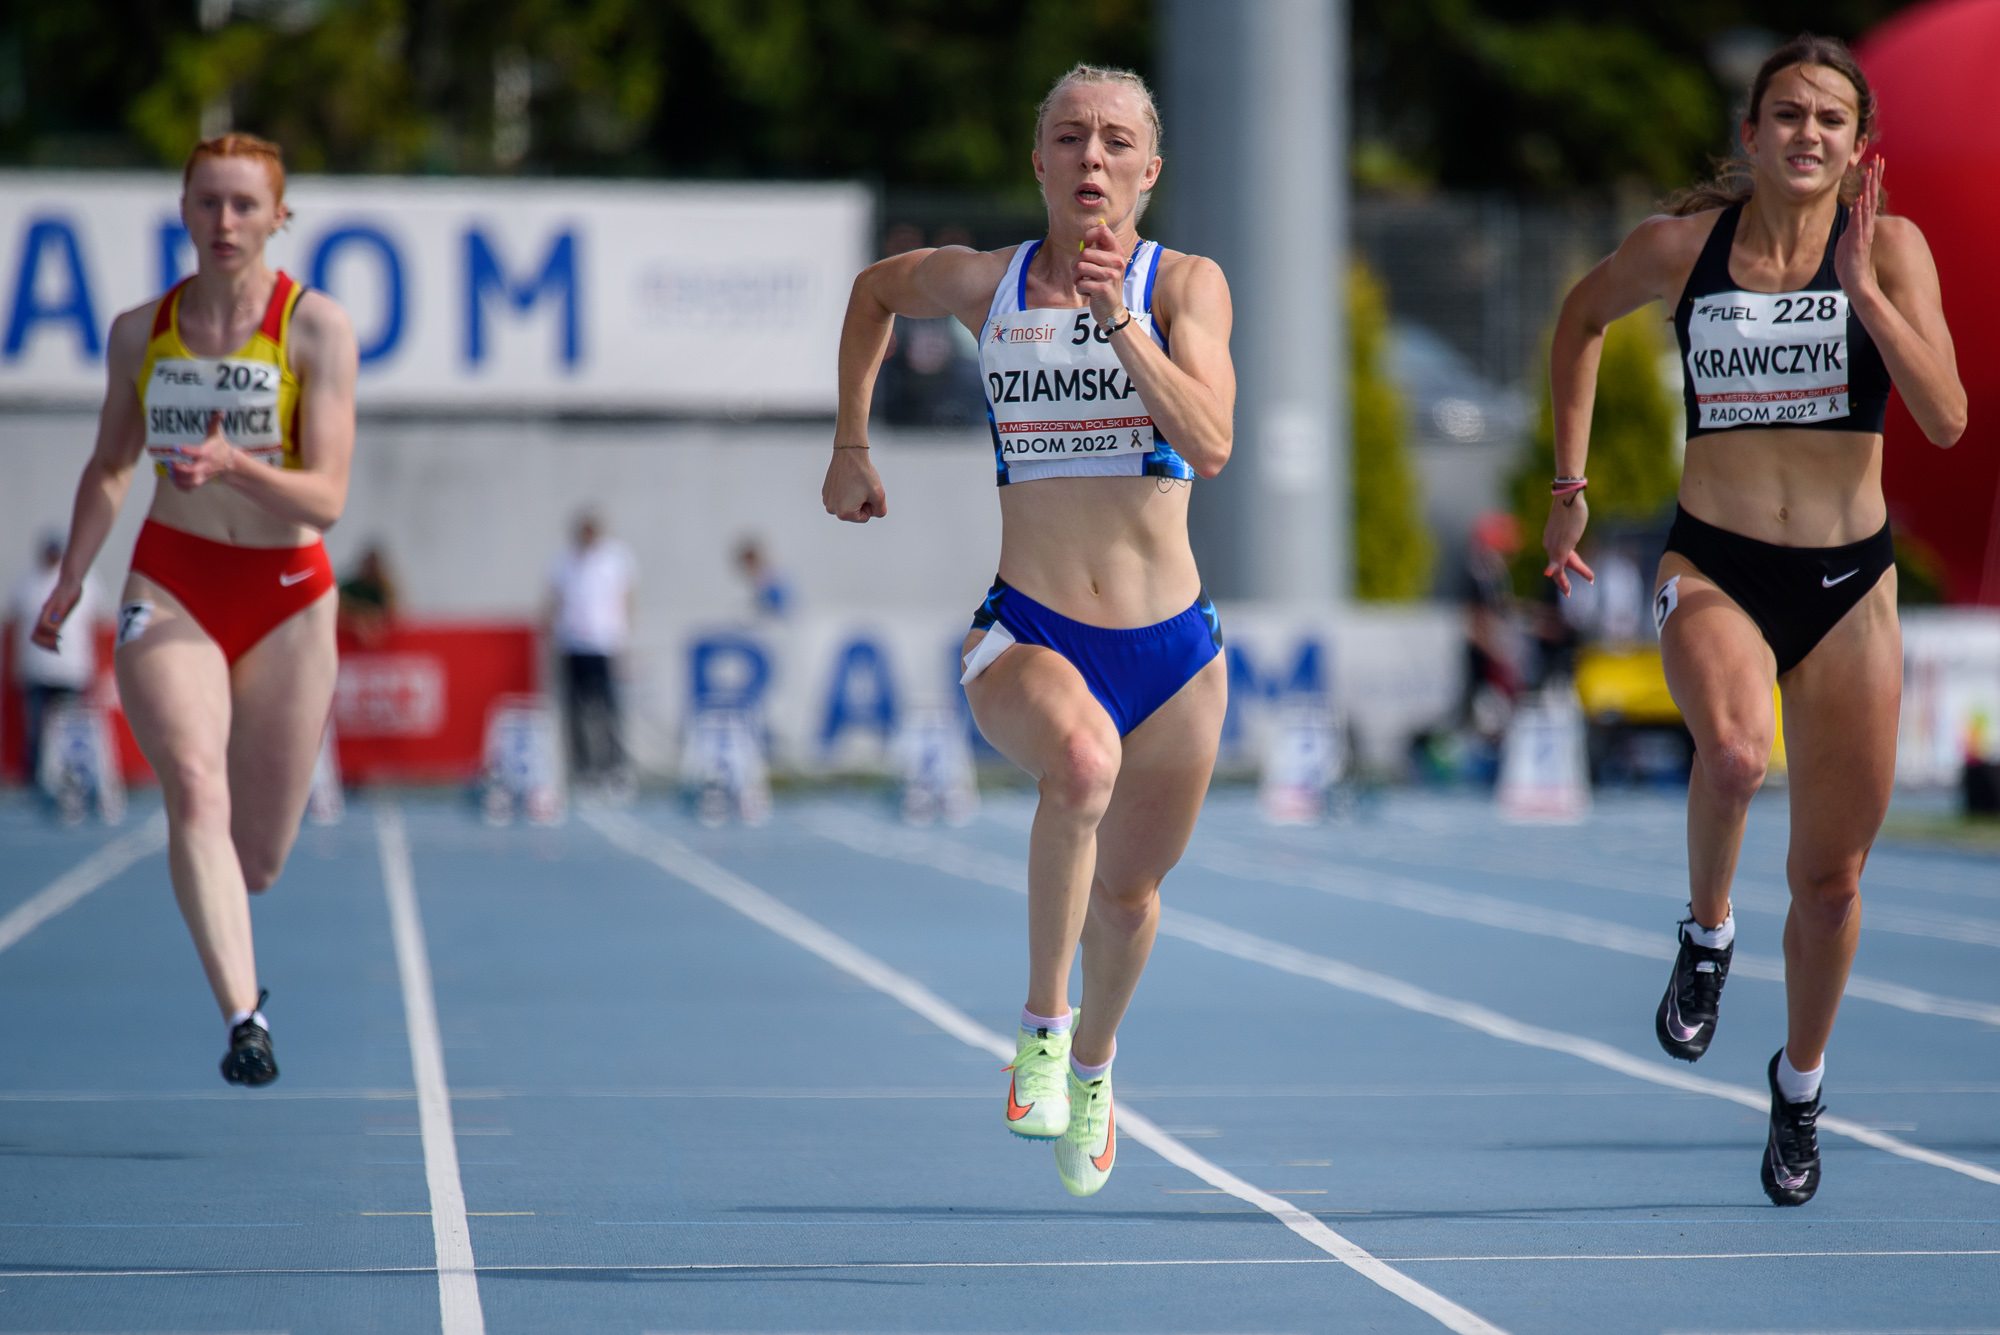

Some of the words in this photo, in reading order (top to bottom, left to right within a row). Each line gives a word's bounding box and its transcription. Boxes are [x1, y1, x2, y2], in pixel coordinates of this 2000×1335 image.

[3, 212, 586, 372] AOM
[1710, 306, 1758, 322] FUEL
[1772, 296, 1837, 324] 228
[1010, 324, 1056, 341] mosir
[1694, 342, 1842, 378] KRAWCZYK
[215, 364, 271, 391] 202
[1790, 389, 1823, 399] POLSKI
[1825, 386, 1845, 395] U20
[151, 407, 273, 434] SIENKIWICZ
[1709, 407, 1770, 422] RADOM
[1776, 402, 1818, 420] 2022
[1009, 421, 1083, 432] MISTRZOSTWA
[1086, 418, 1123, 430] POLSKI
[1126, 417, 1149, 426] U20
[1002, 437, 1066, 454] ADOM
[1071, 434, 1118, 452] 2022
